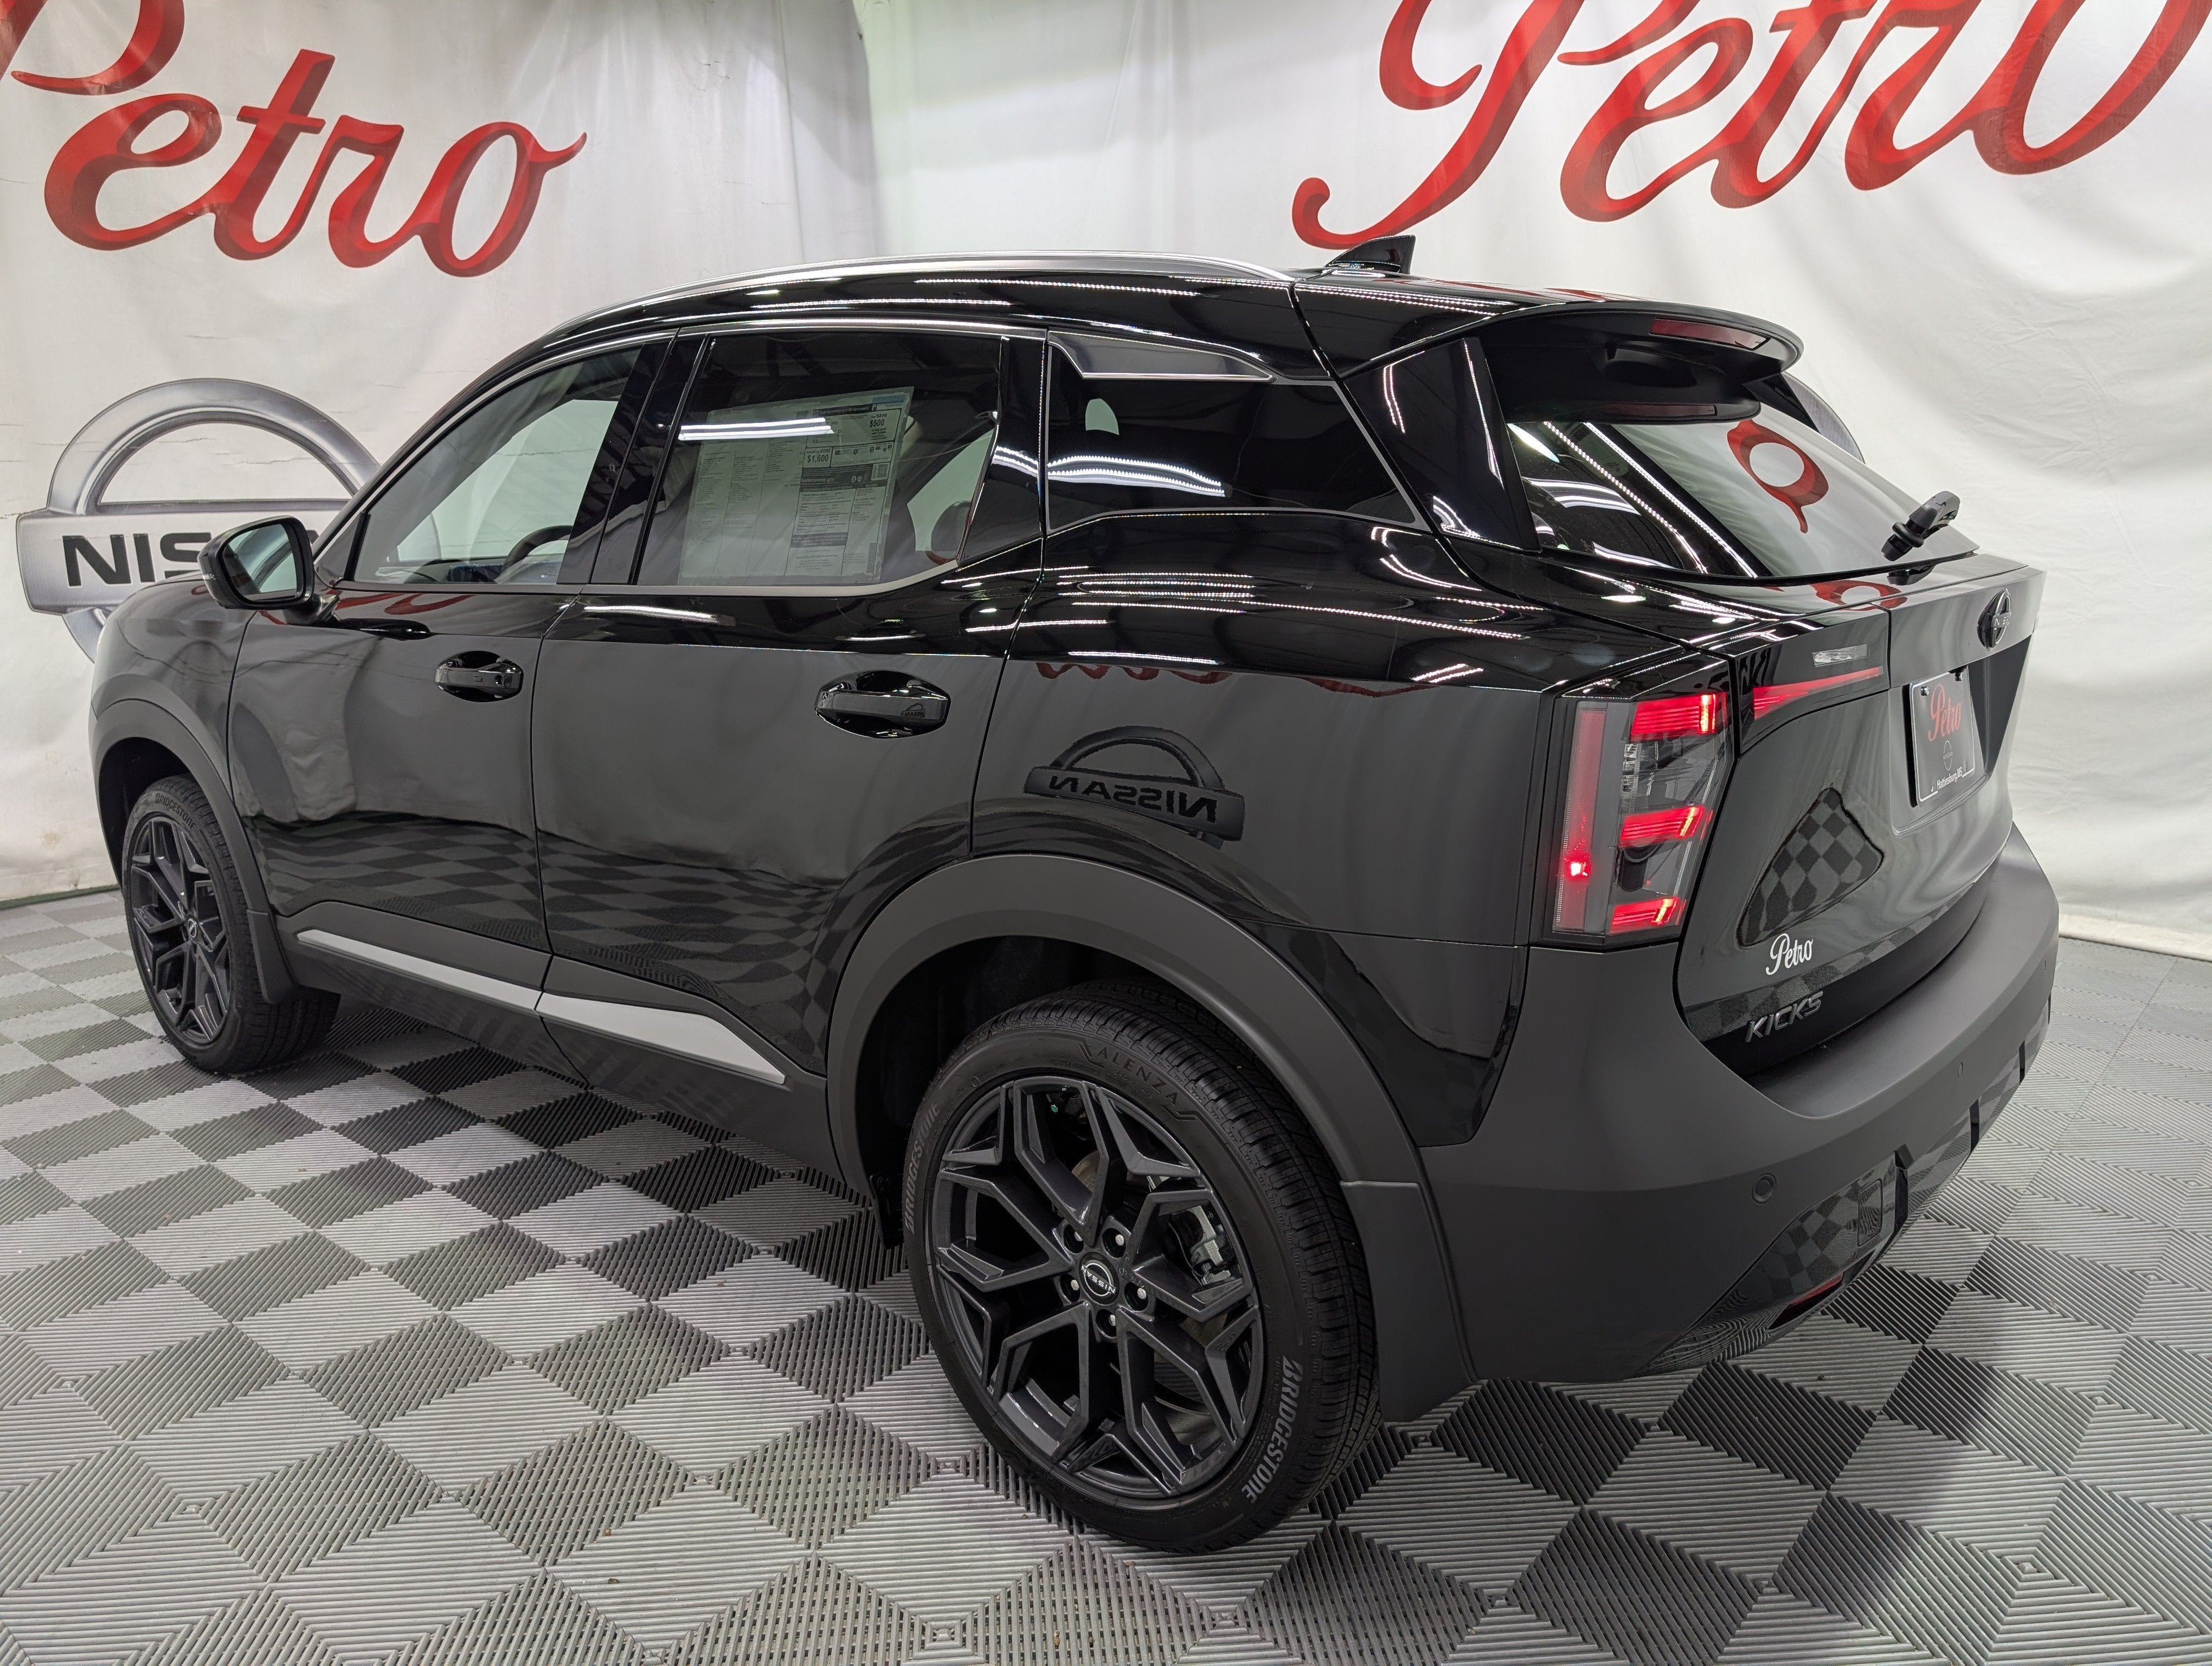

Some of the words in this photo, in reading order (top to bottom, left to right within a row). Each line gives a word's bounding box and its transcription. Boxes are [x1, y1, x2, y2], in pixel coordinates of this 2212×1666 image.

[870, 419, 885, 428] $500
[807, 454, 829, 463] $1,600
[1927, 684, 1962, 741] Petro
[155, 793, 196, 830] BRIDGESTONE
[1766, 933, 1814, 975] Petro
[1745, 990, 1823, 1042] KICKS
[1097, 1046, 1178, 1107] ALENZA
[905, 1103, 940, 1235] BRIDGESTONE
[1081, 1264, 1116, 1294] NISSAN
[1242, 1356, 1303, 1503] BRIDGESTONE
